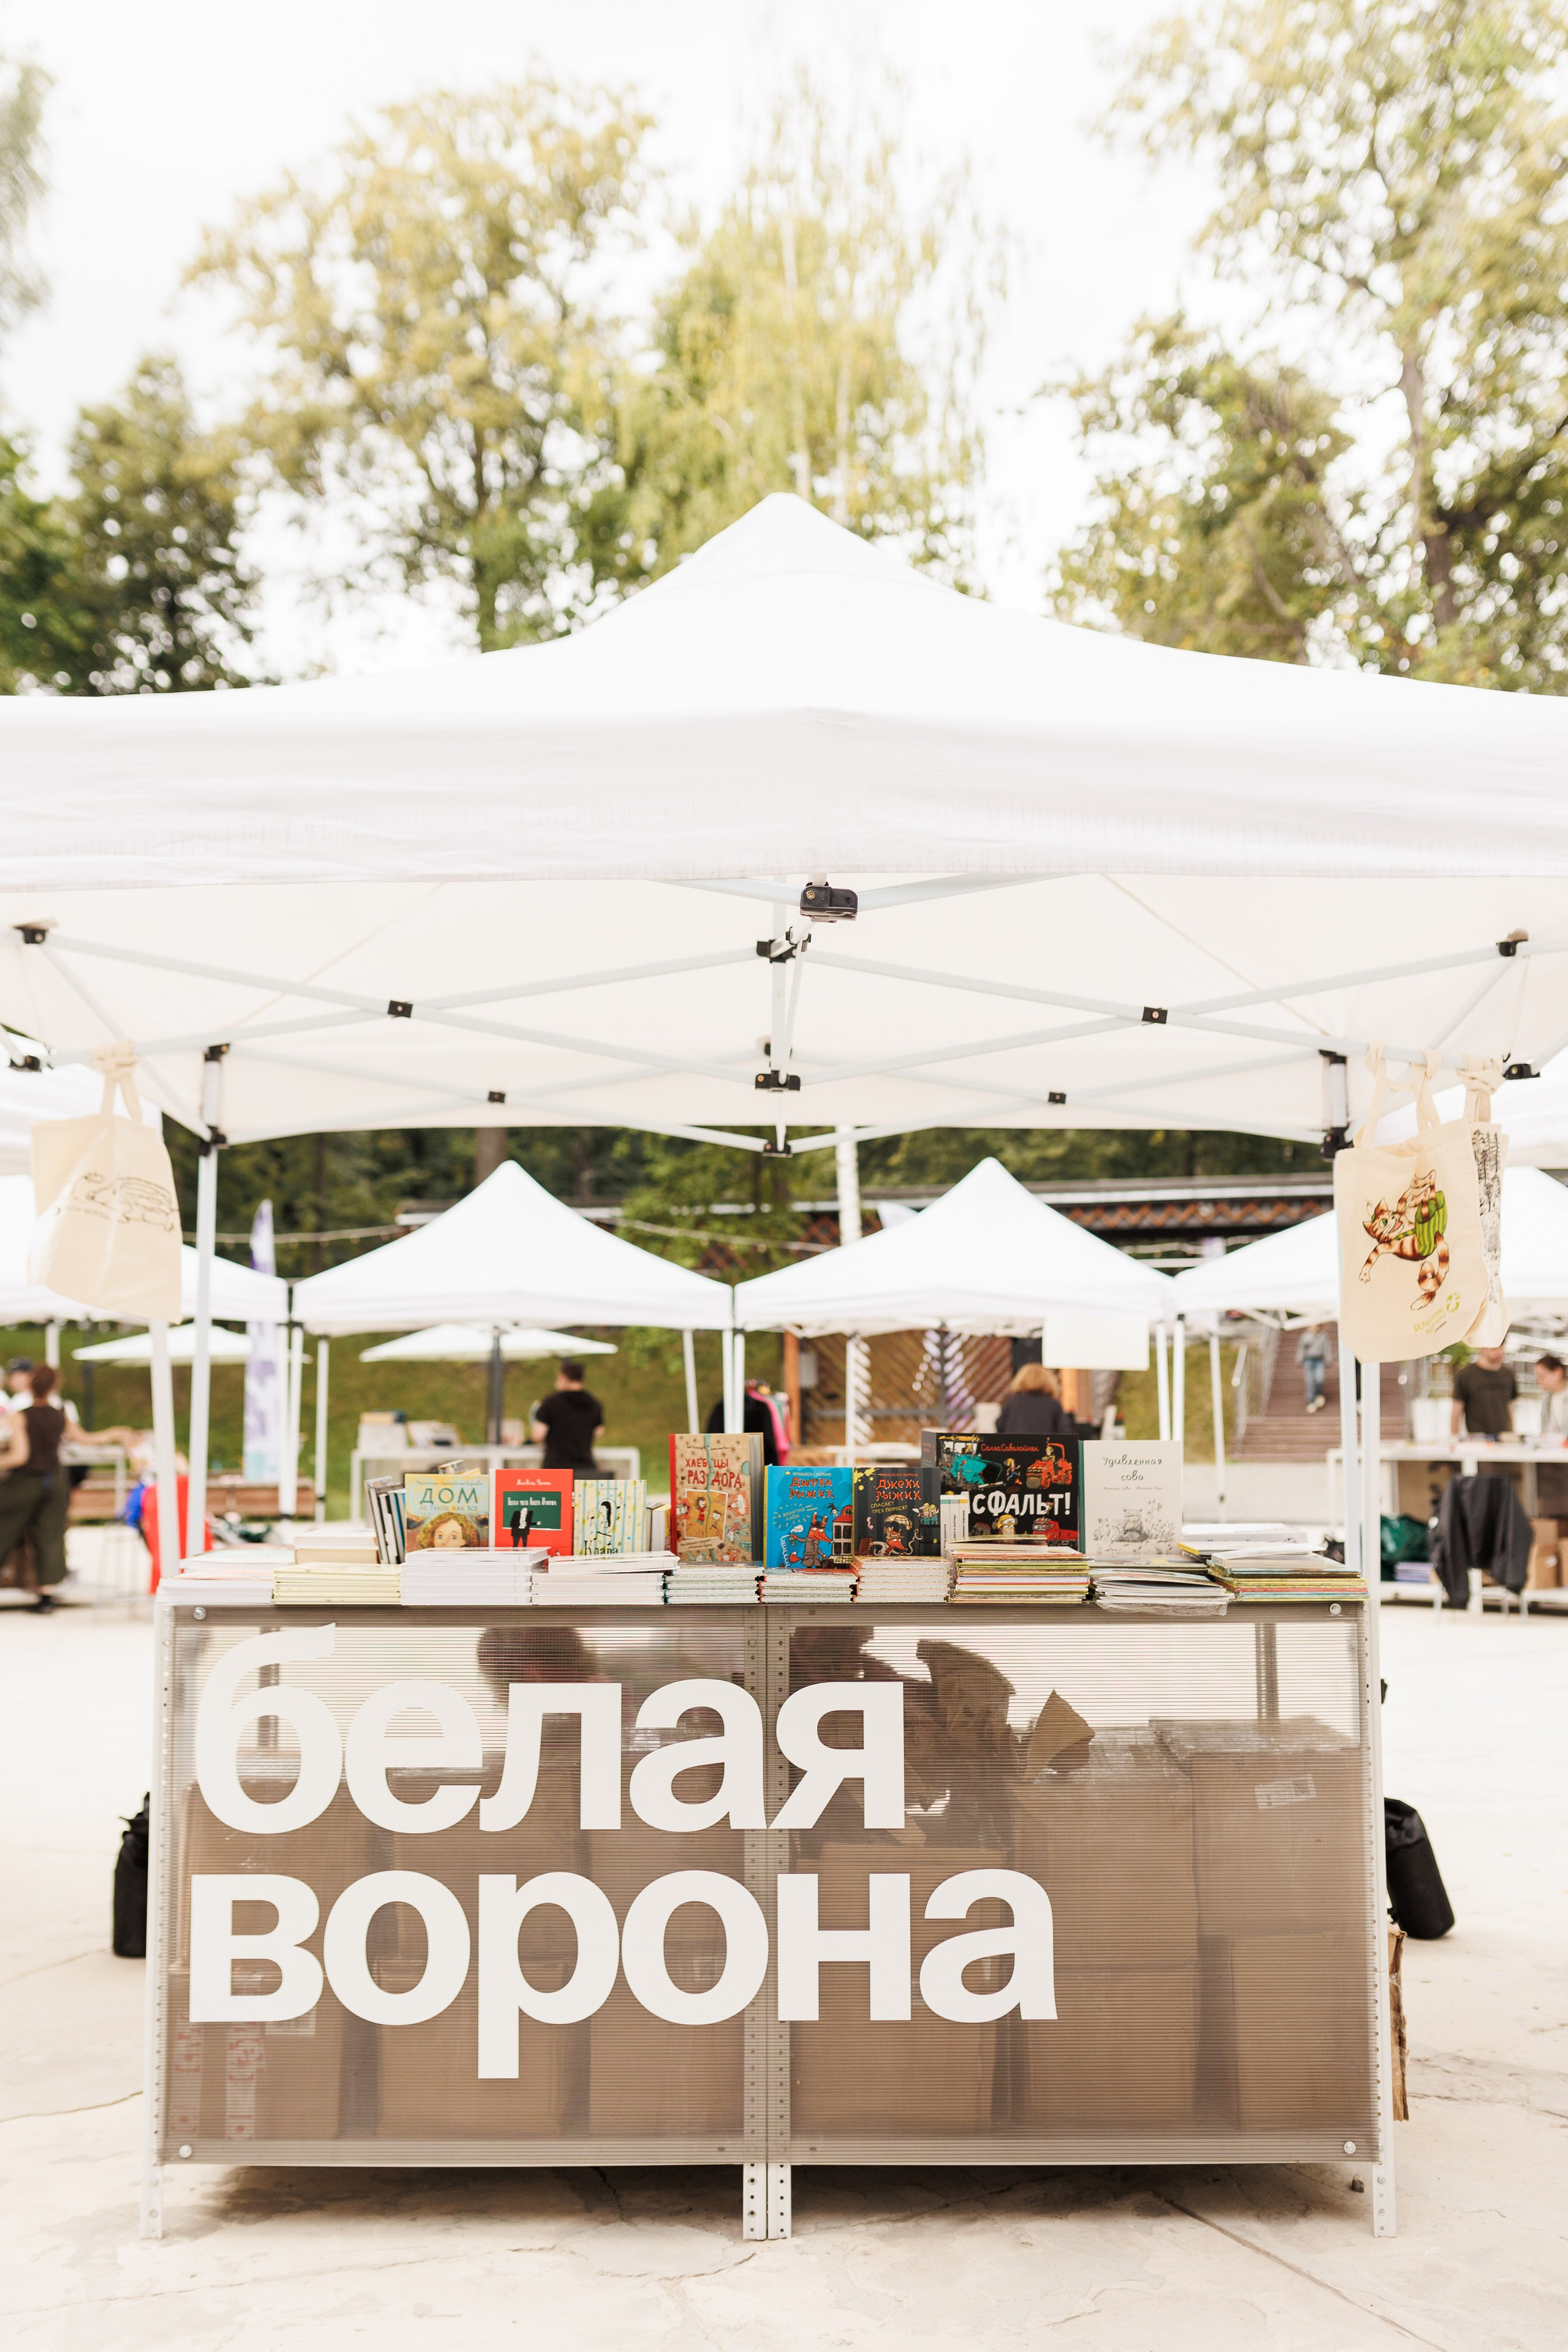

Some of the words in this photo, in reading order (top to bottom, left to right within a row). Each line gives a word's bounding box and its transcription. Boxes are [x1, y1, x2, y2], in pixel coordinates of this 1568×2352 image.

[1102, 1454, 1163, 1468] Удивленная
[1121, 1470, 1144, 1481] сова
[420, 1487, 478, 1504] ДОМ
[194, 1623, 904, 1833] белая
[189, 1869, 1058, 2079] ворона
